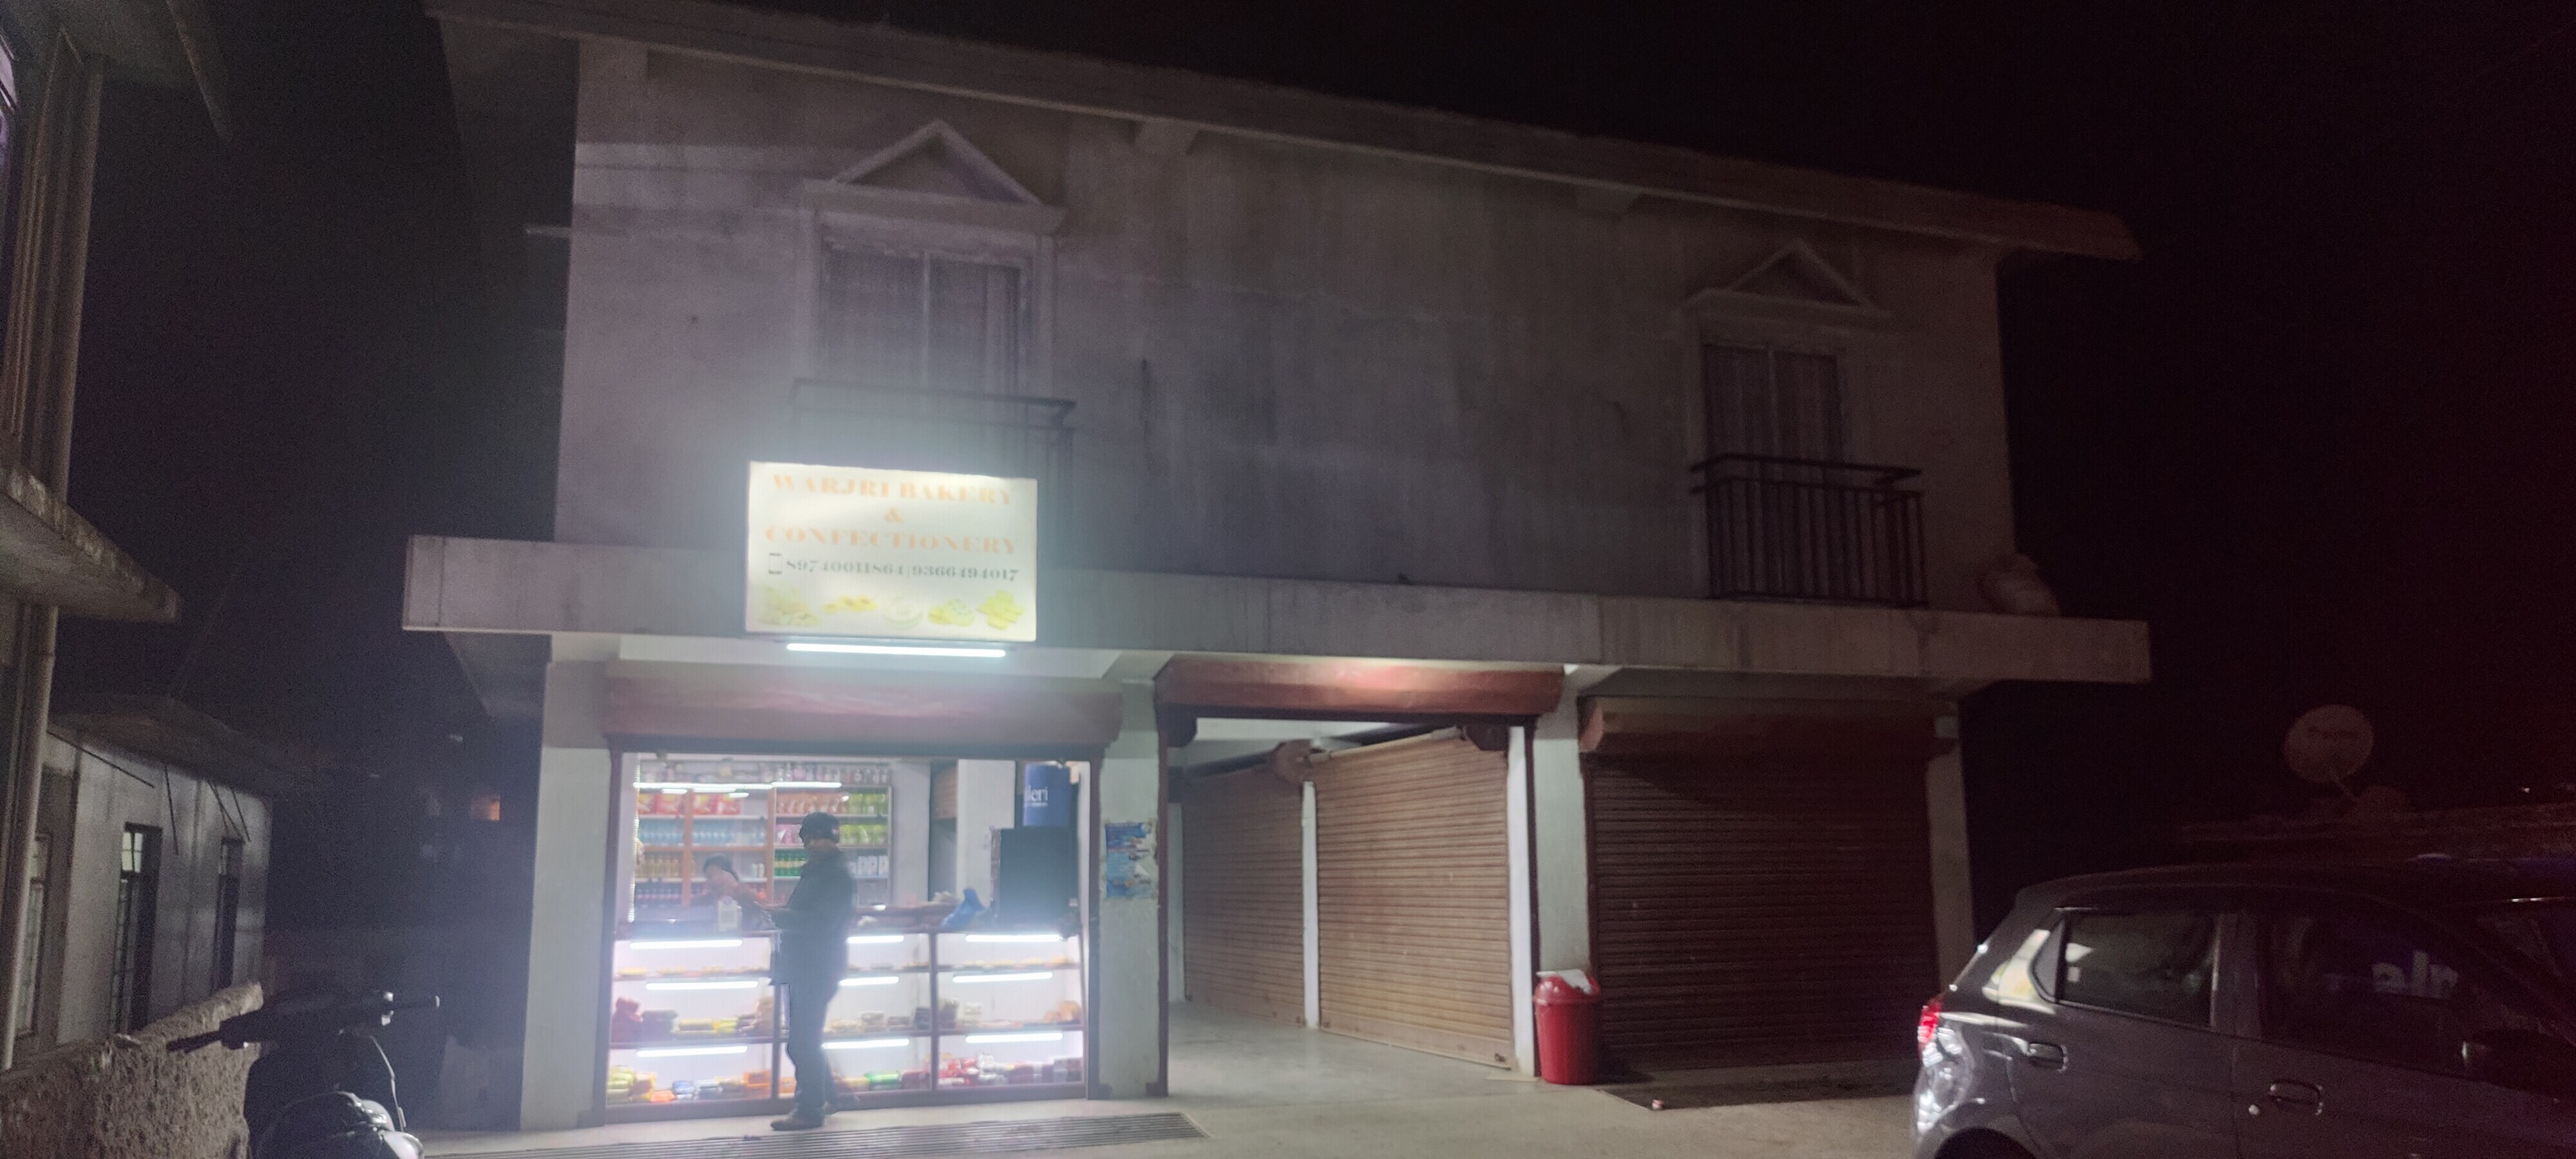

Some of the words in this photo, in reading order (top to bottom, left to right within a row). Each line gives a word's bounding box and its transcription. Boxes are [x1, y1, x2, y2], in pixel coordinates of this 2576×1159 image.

[773, 473, 889, 498] WARJRI
[900, 482, 1014, 505] BAKERY
[884, 506, 905, 523] &
[765, 525, 1018, 554] CONFECTIONERY
